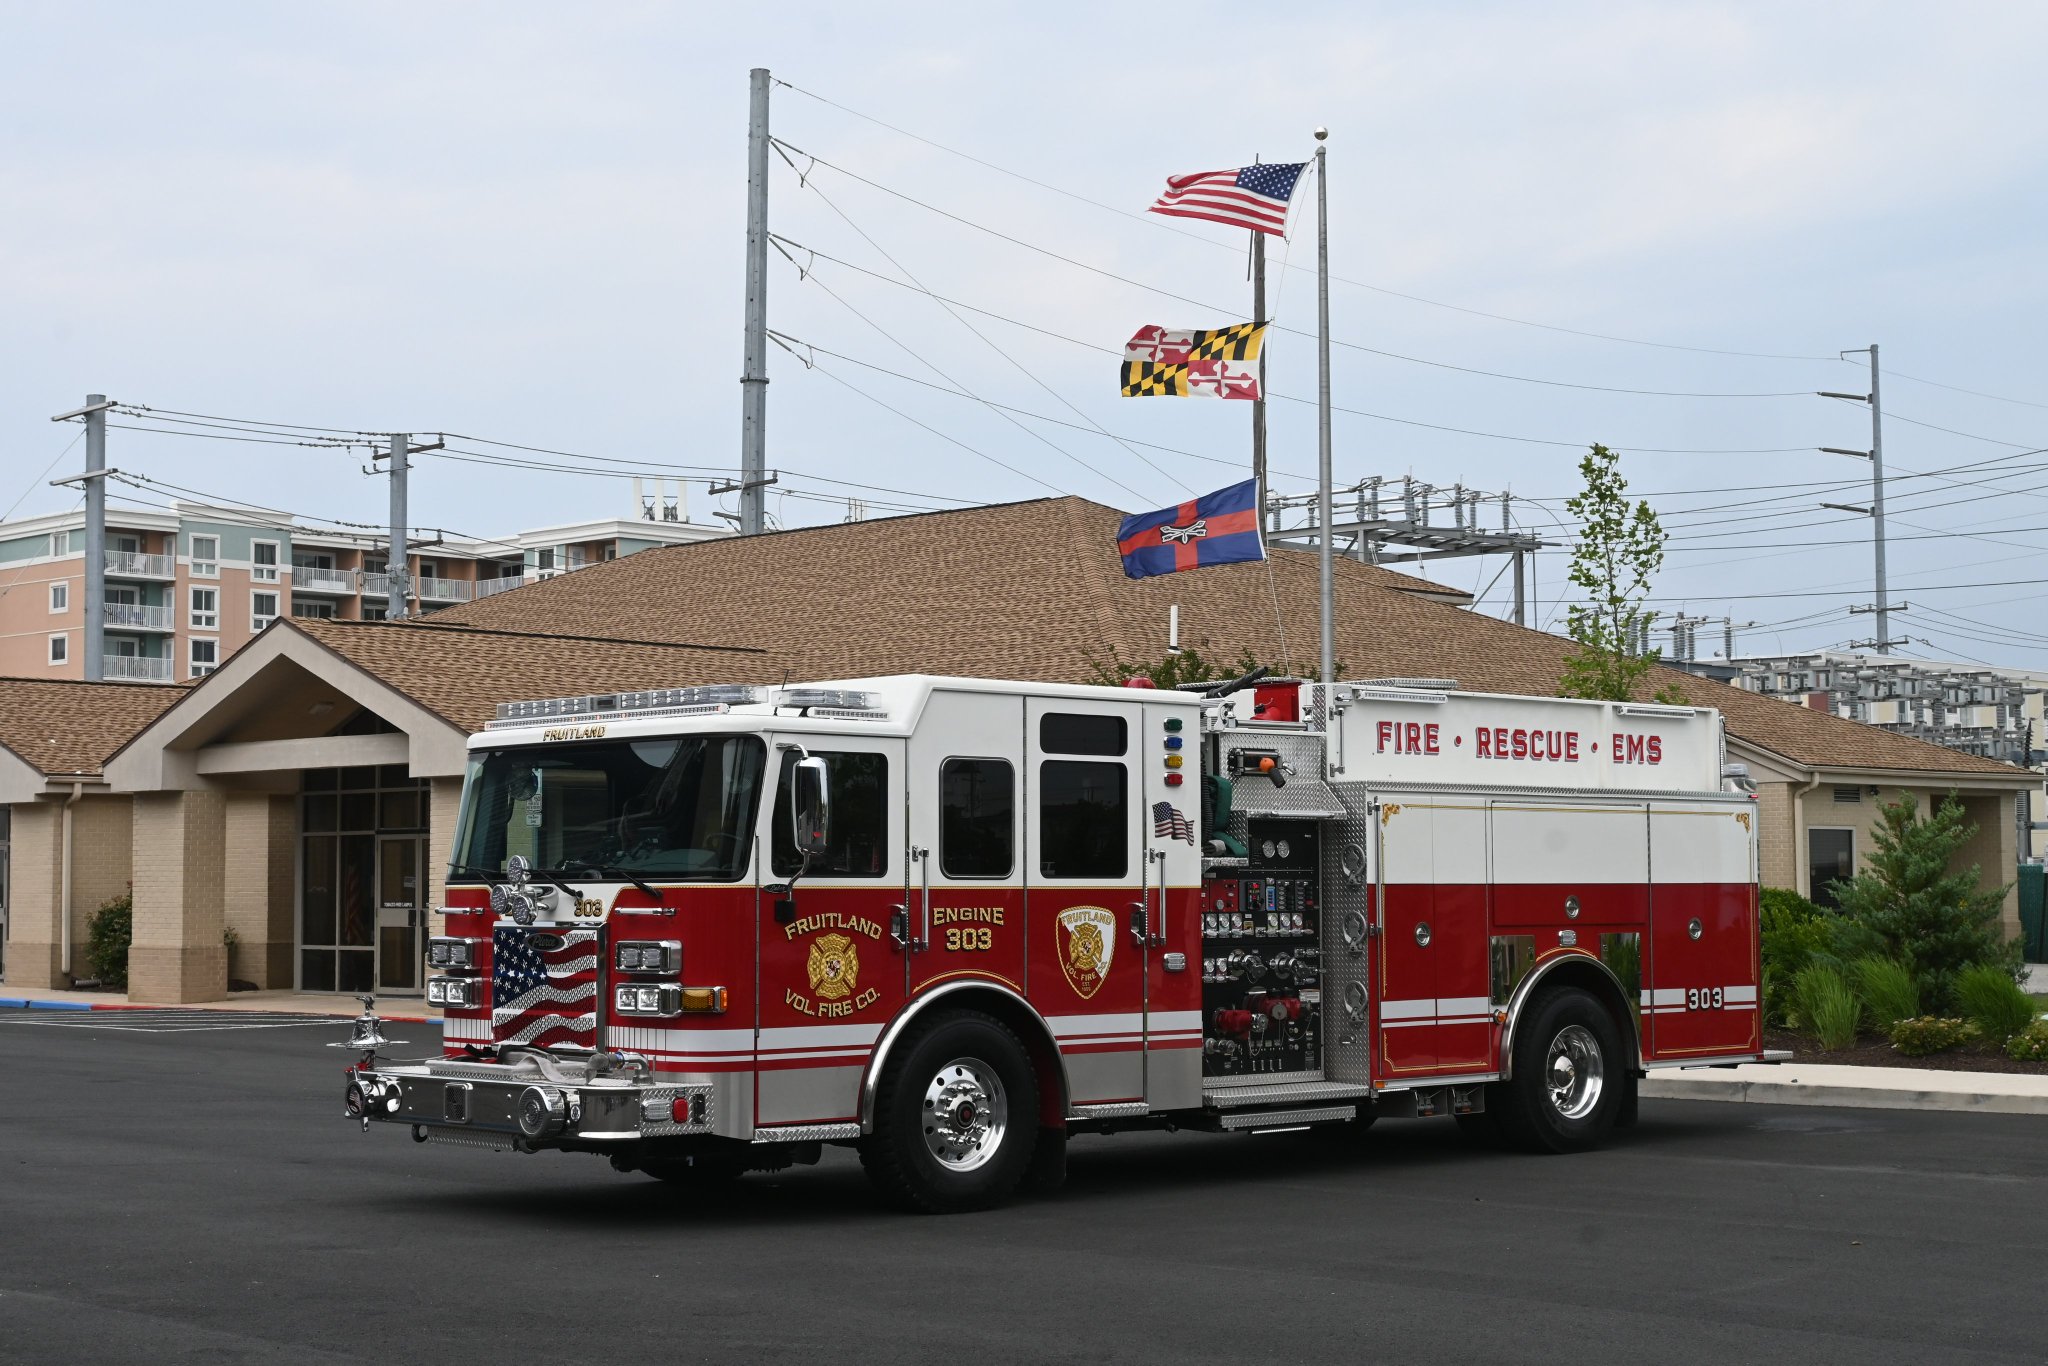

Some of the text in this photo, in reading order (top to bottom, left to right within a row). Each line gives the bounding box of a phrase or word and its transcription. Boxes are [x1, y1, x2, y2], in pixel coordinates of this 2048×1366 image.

[543, 724, 606, 741] FRUITLAND
[1376, 721, 1662, 765] FIRE RESCUE EMS
[574, 898, 603, 917] 303
[933, 907, 1004, 926] ENGINE
[784, 912, 882, 940] FRUITLAND
[1061, 911, 1112, 926] FRUITLAND
[945, 928, 992, 951] 303
[1081, 971, 1097, 981] FIRE
[818, 1000, 854, 1018] FIRE
[855, 987, 881, 1010] CO.
[1688, 987, 1722, 1010] 303
